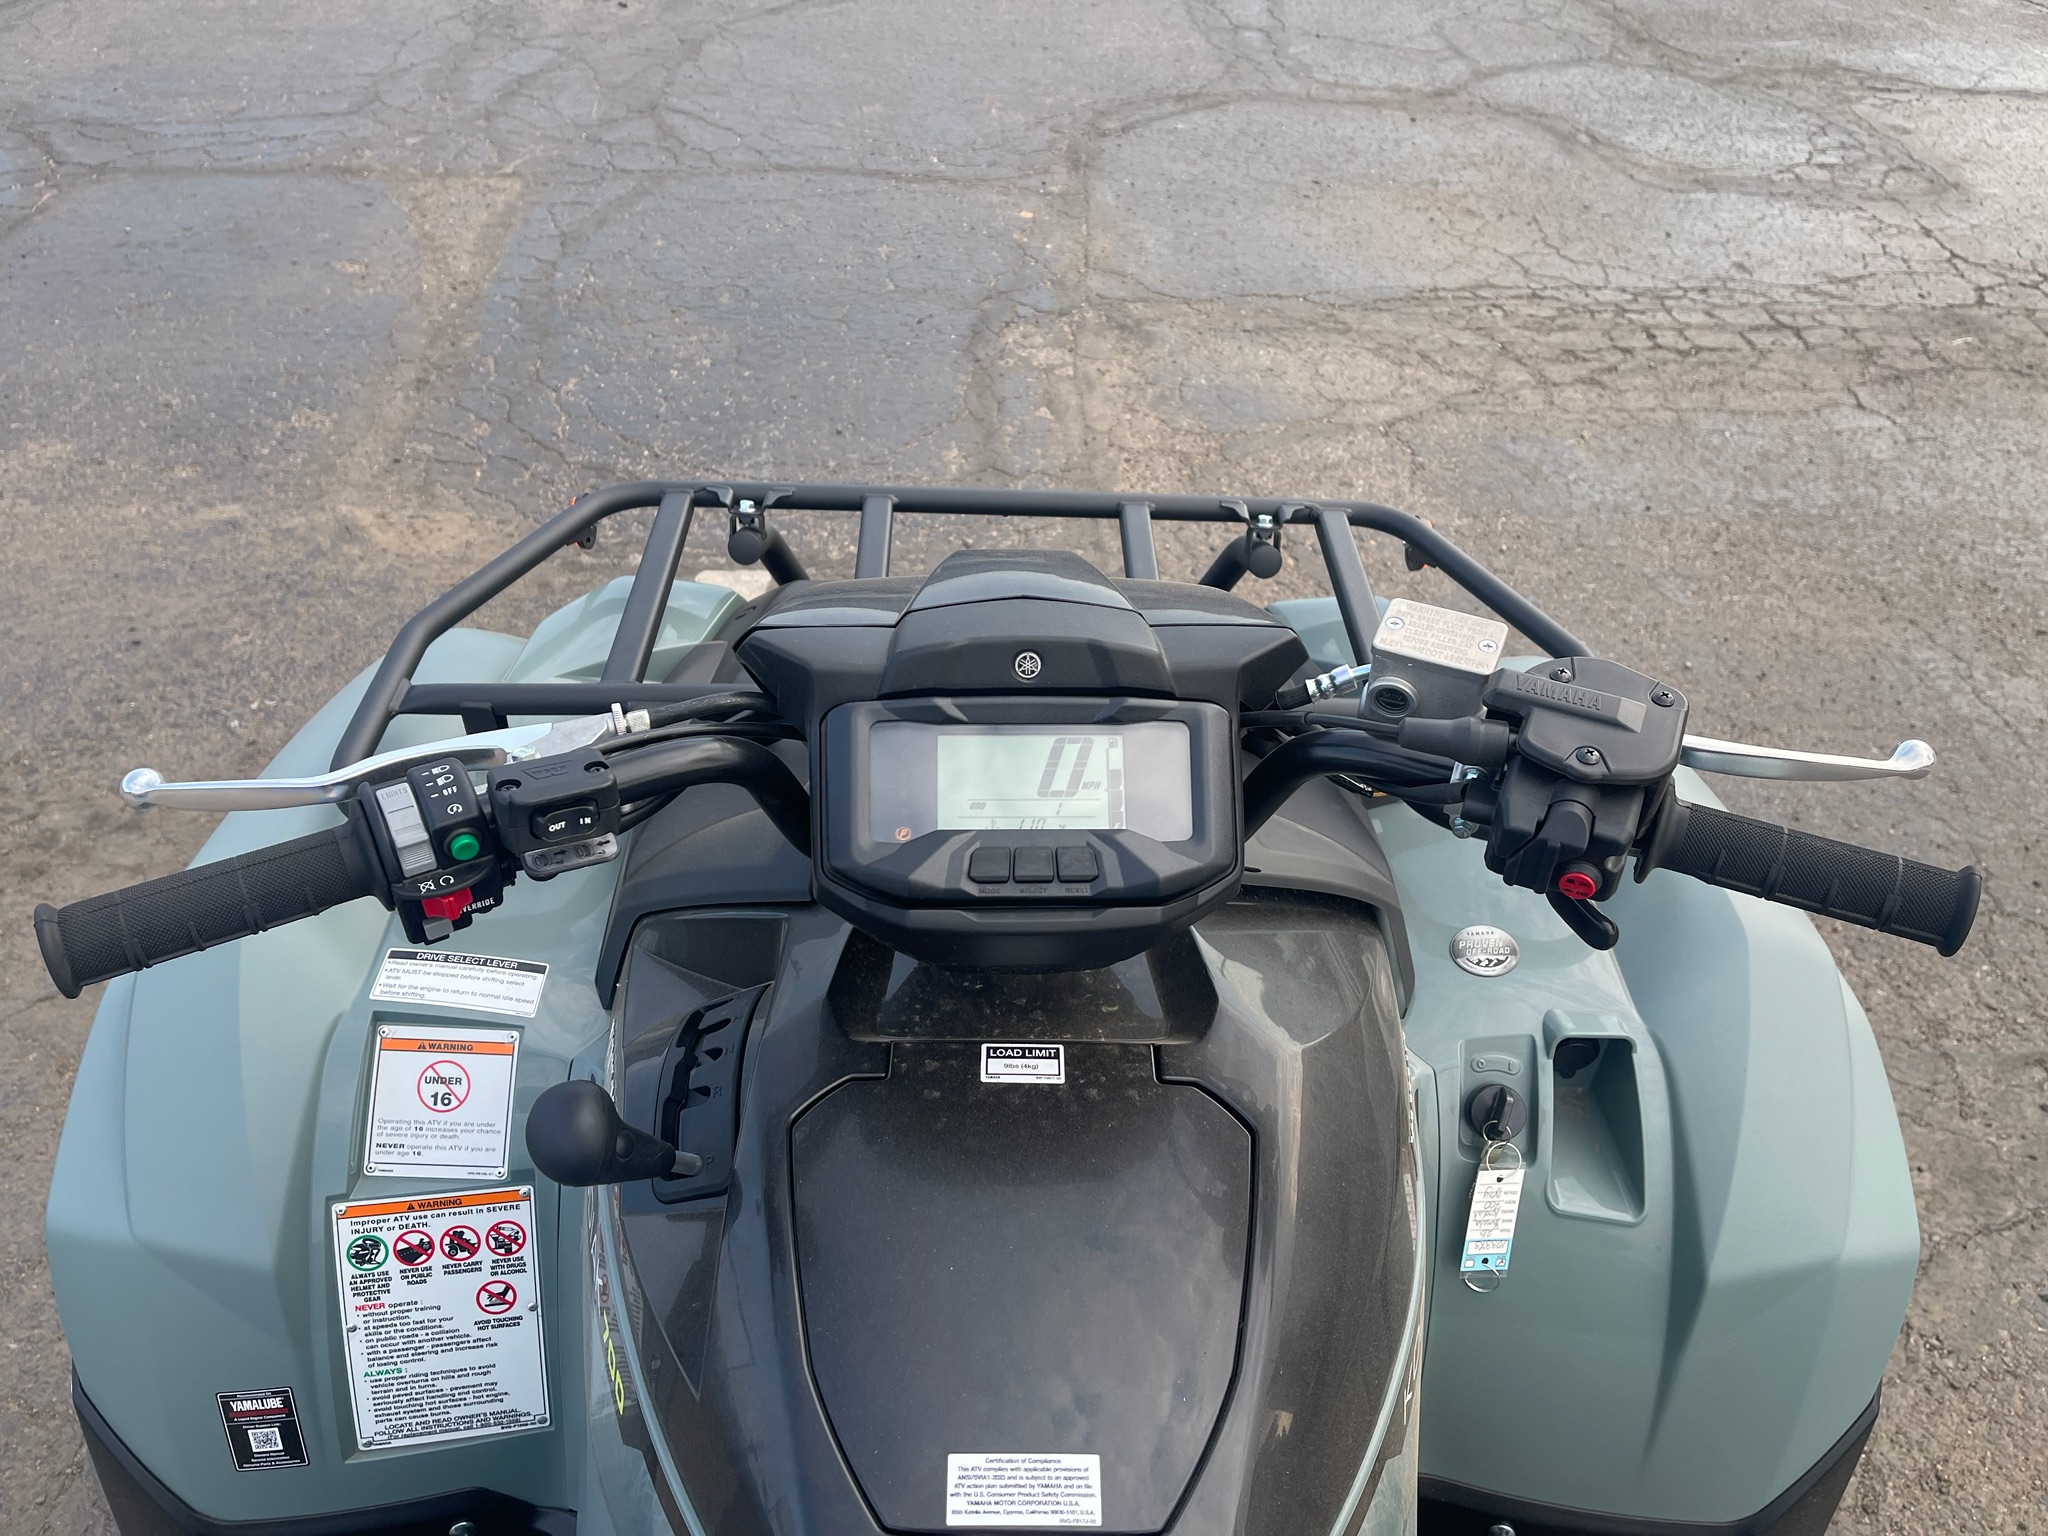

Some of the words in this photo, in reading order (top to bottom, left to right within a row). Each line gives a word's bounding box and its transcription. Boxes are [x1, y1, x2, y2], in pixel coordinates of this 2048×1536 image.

[1516, 674, 1602, 710] YAMAHA
[1037, 737, 1094, 798] 0
[1081, 781, 1101, 790] MPH
[381, 787, 408, 800] LIGHTS
[442, 786, 458, 796] OFF
[969, 802, 987, 810] ODO
[548, 821, 566, 832] OUT
[579, 817, 592, 825] IN
[460, 896, 496, 914] VERRIDE
[1458, 938, 1503, 950] PROVEN
[1465, 946, 1510, 956] OFF-ROAD
[416, 953, 446, 962] DRIVE
[447, 955, 486, 965] SELECT
[487, 959, 518, 969] LEVER
[459, 965, 485, 973] carefully
[486, 967, 508, 975] before
[427, 1042, 473, 1051] WARNING
[989, 1048, 1022, 1057] LOAD
[1025, 1049, 1057, 1057] LIMIT
[424, 1076, 462, 1086] UNDER
[431, 1092, 452, 1107] 16
[377, 1117, 411, 1125] Operating
[416, 1197, 462, 1209] WARNING
[350, 1217, 390, 1226] Improper
[393, 1214, 410, 1222] ATV
[448, 1208, 473, 1216] result
[486, 1203, 520, 1213] SEVERE
[350, 1225, 383, 1234] INJURY
[398, 1221, 430, 1230] DEATH.
[350, 1271, 375, 1279] ALWAYS
[410, 1271, 432, 1279] PUBLIC
[443, 1266, 482, 1275] PASSENGERS
[499, 1267, 527, 1275] ALCOHOL
[359, 1276, 392, 1284] APPROVED
[350, 1283, 375, 1291] HELMET
[352, 1288, 390, 1297] PROTECTIVE
[354, 1302, 385, 1311] NEVER
[387, 1300, 418, 1308] operate
[492, 1314, 523, 1323] TOUCHING
[490, 1321, 520, 1329] SURFACES
[602, 1308, 625, 1415] 700
[363, 1367, 402, 1378] ALWAYS
[373, 1428, 404, 1436] FOLLOW
[420, 1418, 474, 1430] INSTRUCTIONS
[491, 1411, 532, 1421] WARNINGS.
[384, 1421, 413, 1430] LOCATE
[453, 1411, 487, 1421] OWNER'S
[488, 1407, 521, 1416] MANUAL.
